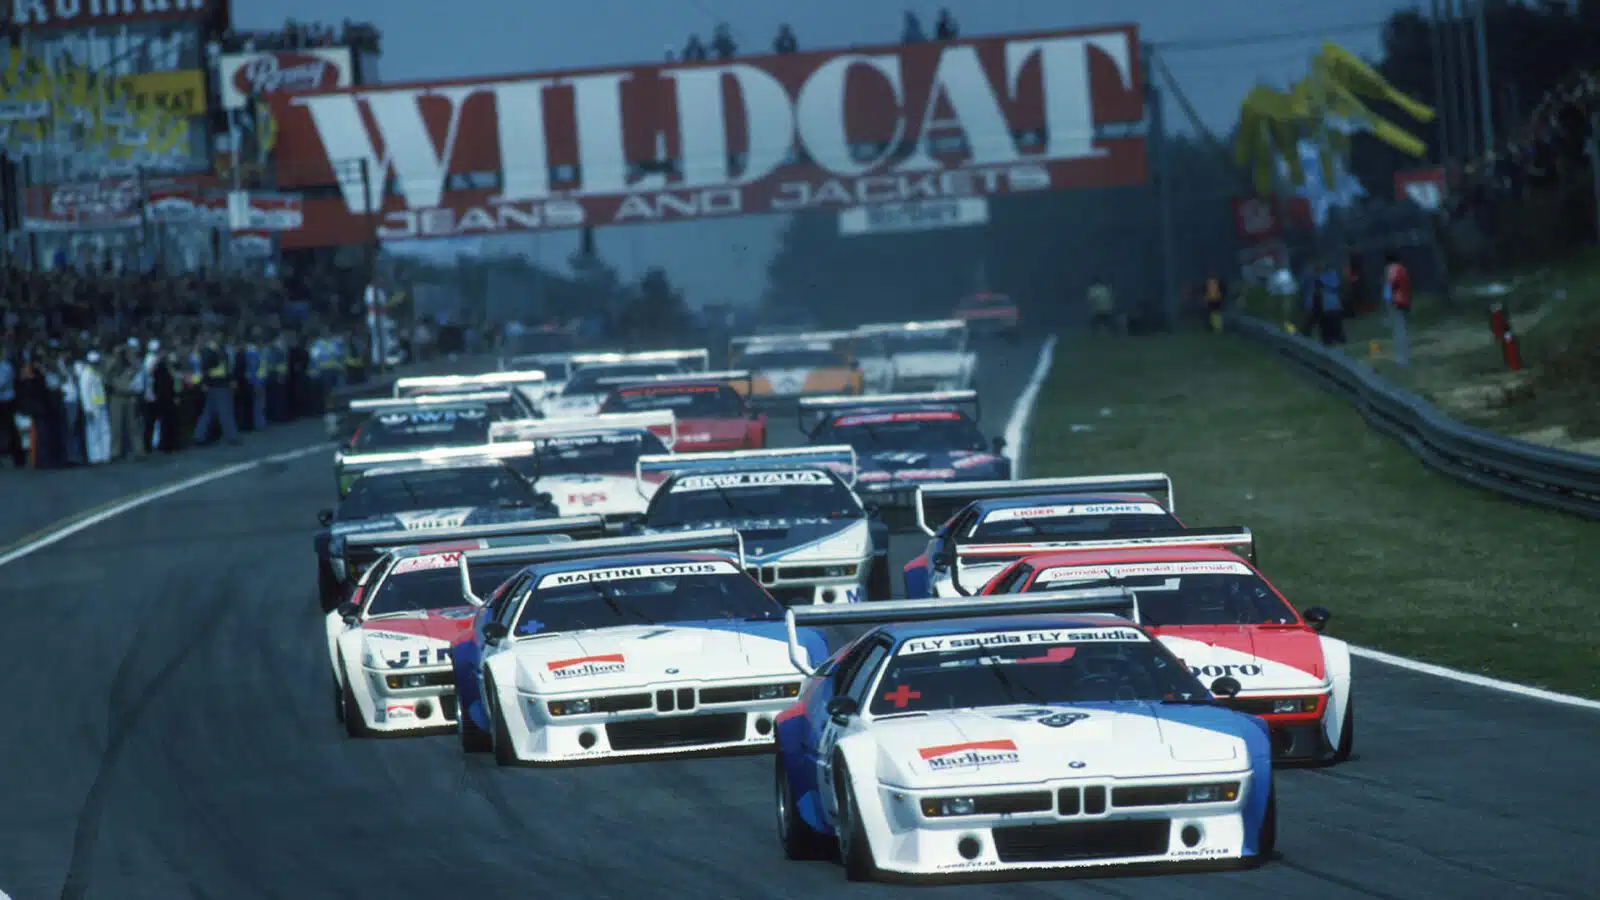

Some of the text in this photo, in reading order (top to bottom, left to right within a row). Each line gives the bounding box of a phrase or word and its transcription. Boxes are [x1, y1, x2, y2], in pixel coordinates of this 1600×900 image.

[290, 31, 1134, 214] WILDCAT
[377, 165, 1051, 237] JEANS AND JACKETS
[750, 470, 815, 483] ITALIA
[1085, 504, 1142, 513] GITANES
[557, 564, 716, 585] MARTINI LOTUS
[909, 629, 1140, 652] FLY saudia FLY saudia
[553, 663, 625, 677] Marlboro
[929, 752, 1019, 767] Marlboro
